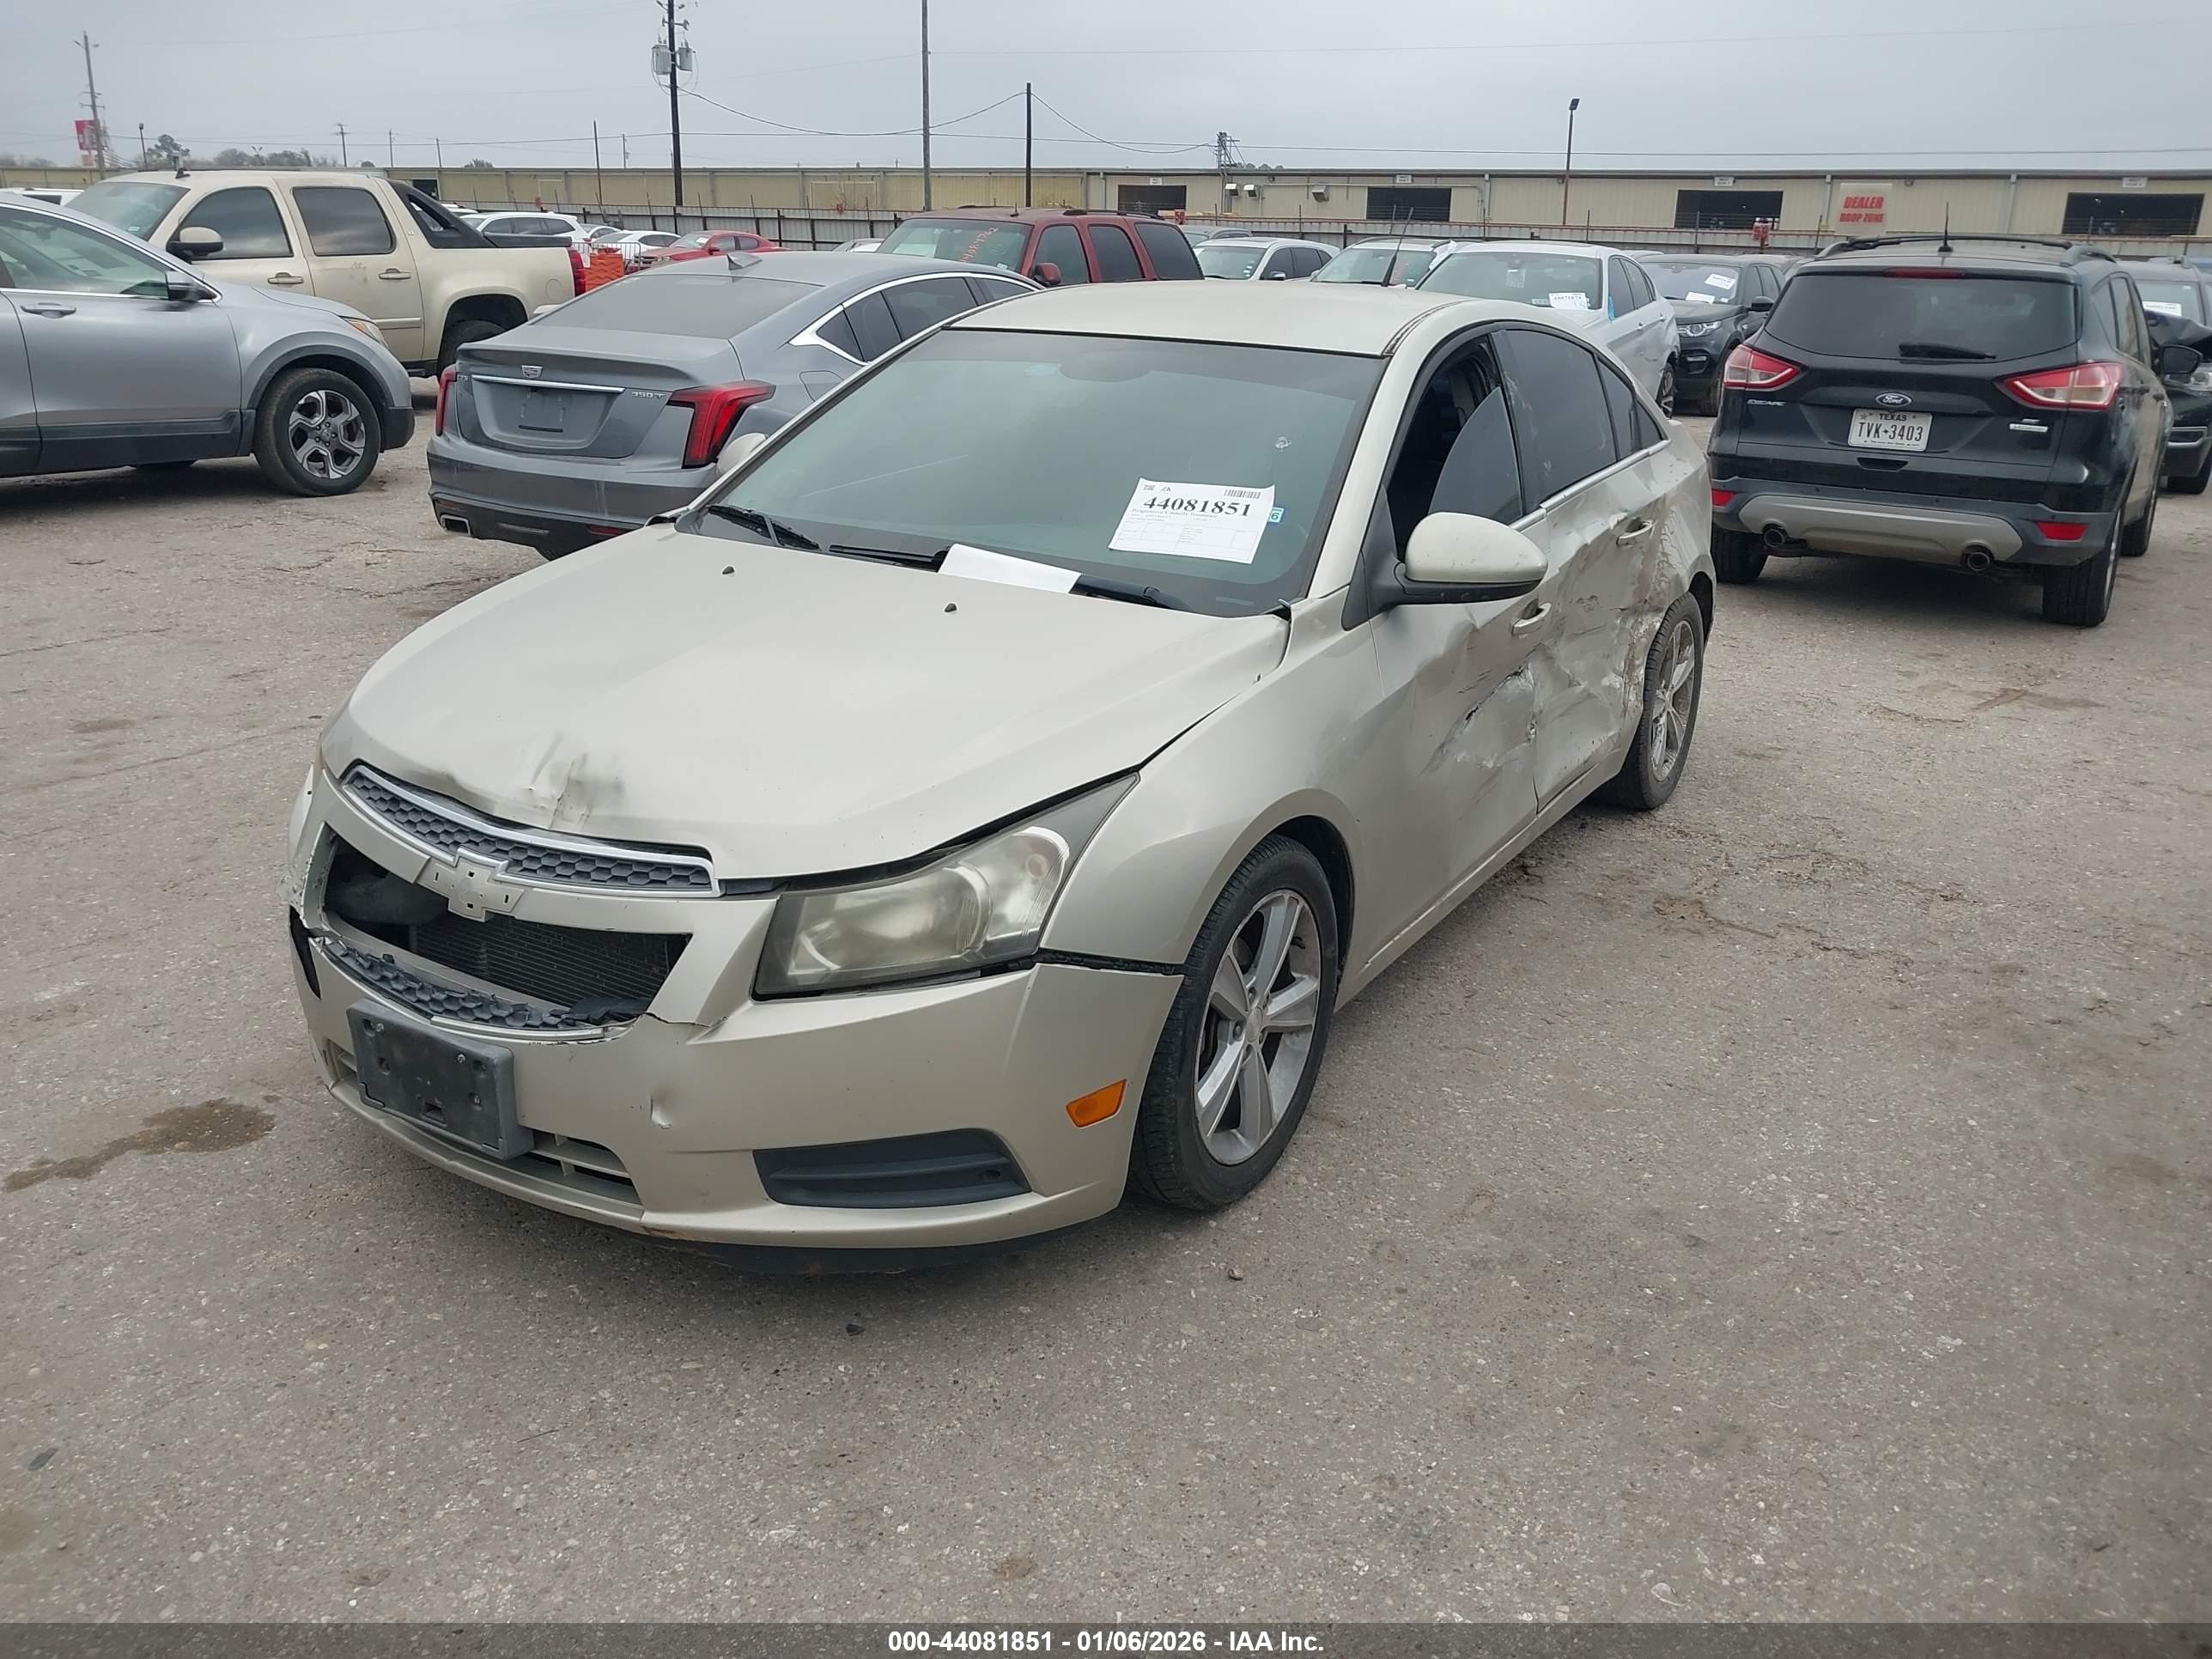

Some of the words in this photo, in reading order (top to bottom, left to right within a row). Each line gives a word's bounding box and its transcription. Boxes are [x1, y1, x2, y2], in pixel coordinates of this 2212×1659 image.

[1843, 196, 1884, 209] DEALER
[1882, 394, 1904, 404] Ford
[1879, 412, 1908, 422] TEXAS
[1143, 495, 1252, 517] 44081851
